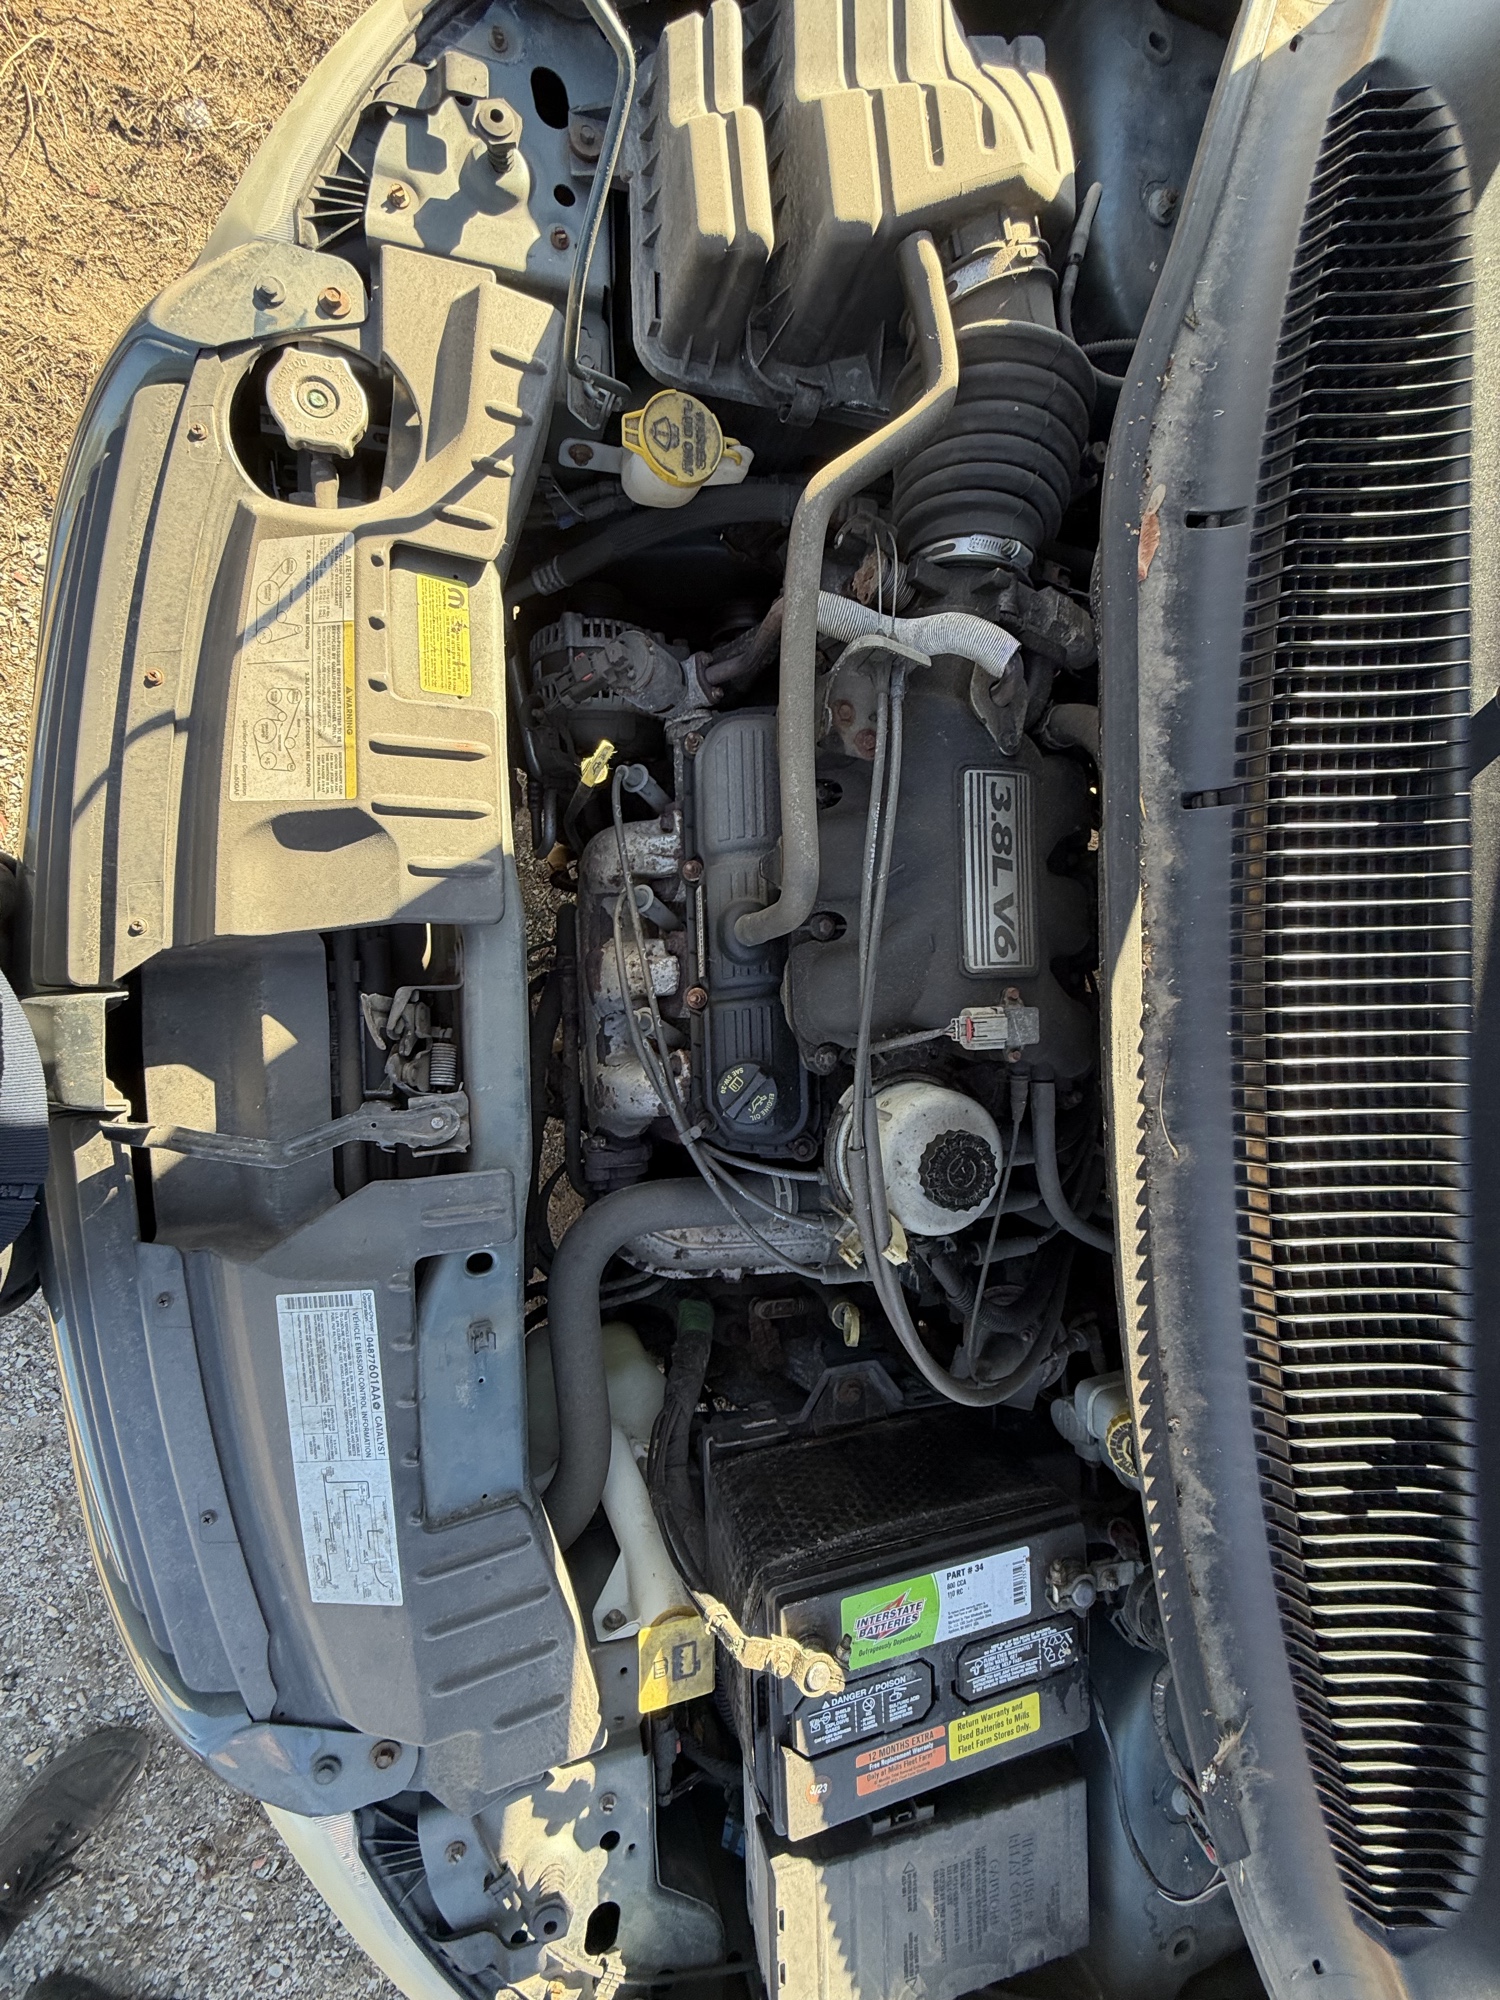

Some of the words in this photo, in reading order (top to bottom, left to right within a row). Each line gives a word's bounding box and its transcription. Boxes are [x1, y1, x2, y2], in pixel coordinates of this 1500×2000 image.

[682, 399, 693, 438] FLUID
[696, 411, 706, 470] WASHER
[682, 441, 694, 477] ONLY
[991, 782, 1013, 886] 3.8L
[993, 893, 1017, 958] V6
[721, 1075, 732, 1094] 5W-20
[732, 1068, 744, 1077] SAE
[760, 1093, 774, 1116] ENGINE
[352, 1311, 361, 1341] VEHICLE
[354, 1342, 364, 1375] EMISSION
[366, 1337, 381, 1401] 04877601AA
[358, 1377, 367, 1409] CONTROL
[361, 1411, 372, 1458] INFORMATION
[374, 1416, 385, 1456] CATALYST
[946, 1568, 965, 1580] PART
[975, 1563, 984, 1572] 34
[957, 1579, 966, 1588] CCA
[857, 1601, 923, 1628] INTERSTATE
[859, 1613, 918, 1638] BATTERIES
[859, 1642, 891, 1657] Outrageously
[893, 1633, 921, 1646] Dependable
[1008, 1644, 1033, 1655] IMMEDIATELY
[984, 1665, 1001, 1673] MEDICAL
[1012, 1657, 1022, 1665] FAST
[831, 1688, 866, 1706] DANGER
[875, 1676, 906, 1692] POISON
[825, 1718, 849, 1730] EXPLOSIVE
[835, 1707, 851, 1715] SHIELD
[957, 1719, 979, 1731] Return
[980, 1708, 1010, 1724] Warranty
[1012, 1701, 1023, 1712] and
[825, 1726, 840, 1735] GASES
[957, 1732, 974, 1742] Used
[975, 1720, 1004, 1736] Batteries
[1014, 1711, 1030, 1722] Mills
[958, 1742, 974, 1754] Fleet
[976, 1737, 992, 1748] Farm
[994, 1729, 1014, 1742] Stores
[1016, 1723, 1031, 1735] Only.
[868, 1752, 877, 1762] 12
[878, 1739, 910, 1758] MONTHS
[911, 1731, 934, 1747] EXTRA
[868, 1762, 880, 1771] Free
[881, 1750, 912, 1768] Replacement
[912, 1742, 934, 1755] Warranty
[866, 1772, 880, 1783] Only
[880, 1770, 886, 1778] at
[888, 1763, 902, 1774] Mills
[903, 1757, 918, 1768] Fleet
[810, 1783, 828, 1796] 3/23
